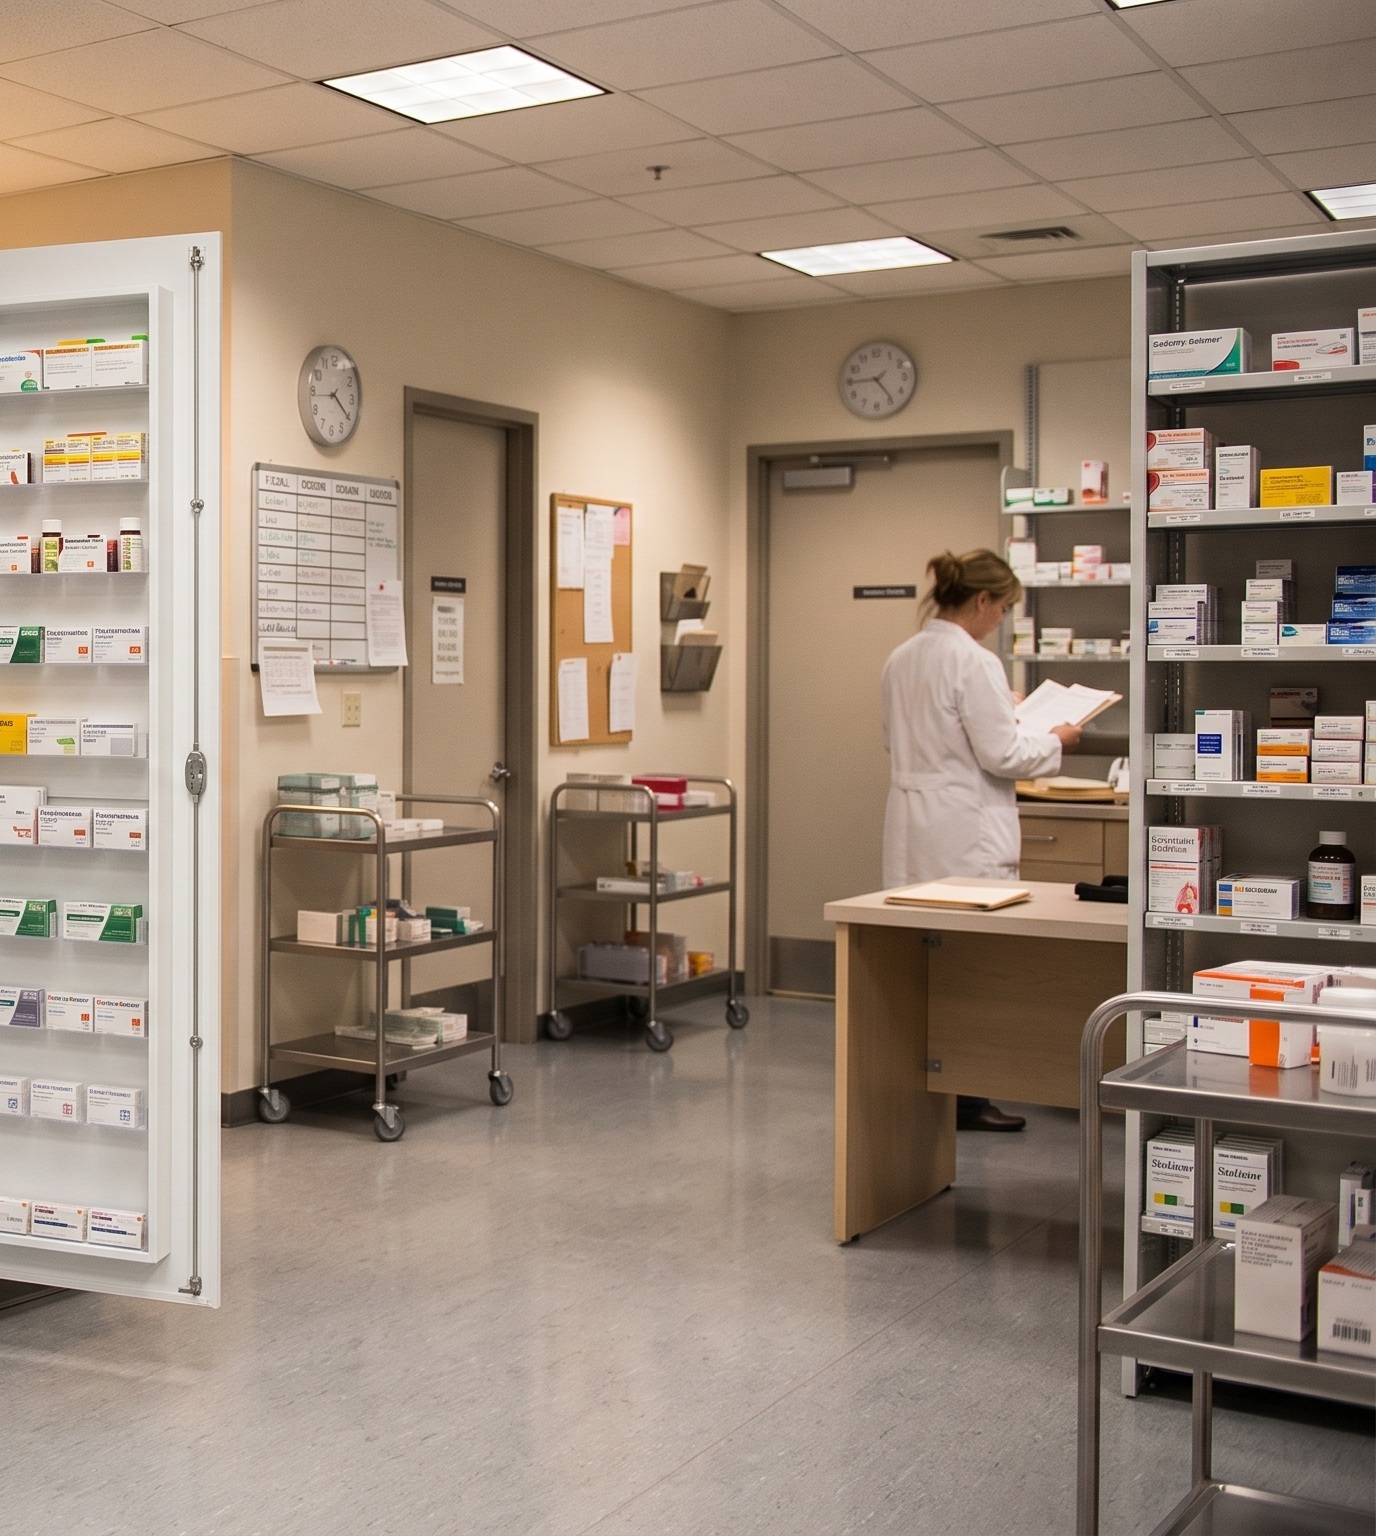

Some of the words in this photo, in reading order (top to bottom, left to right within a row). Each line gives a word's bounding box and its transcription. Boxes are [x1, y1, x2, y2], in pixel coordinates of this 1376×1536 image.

[321, 357, 328, 370] 11
[347, 376, 353, 387] 2
[310, 385, 316, 396] 9
[349, 394, 354, 405] 3
[313, 404, 318, 415] 8
[320, 417, 326, 429] 7
[339, 421, 344, 434] 5
[329, 425, 334, 436] 6
